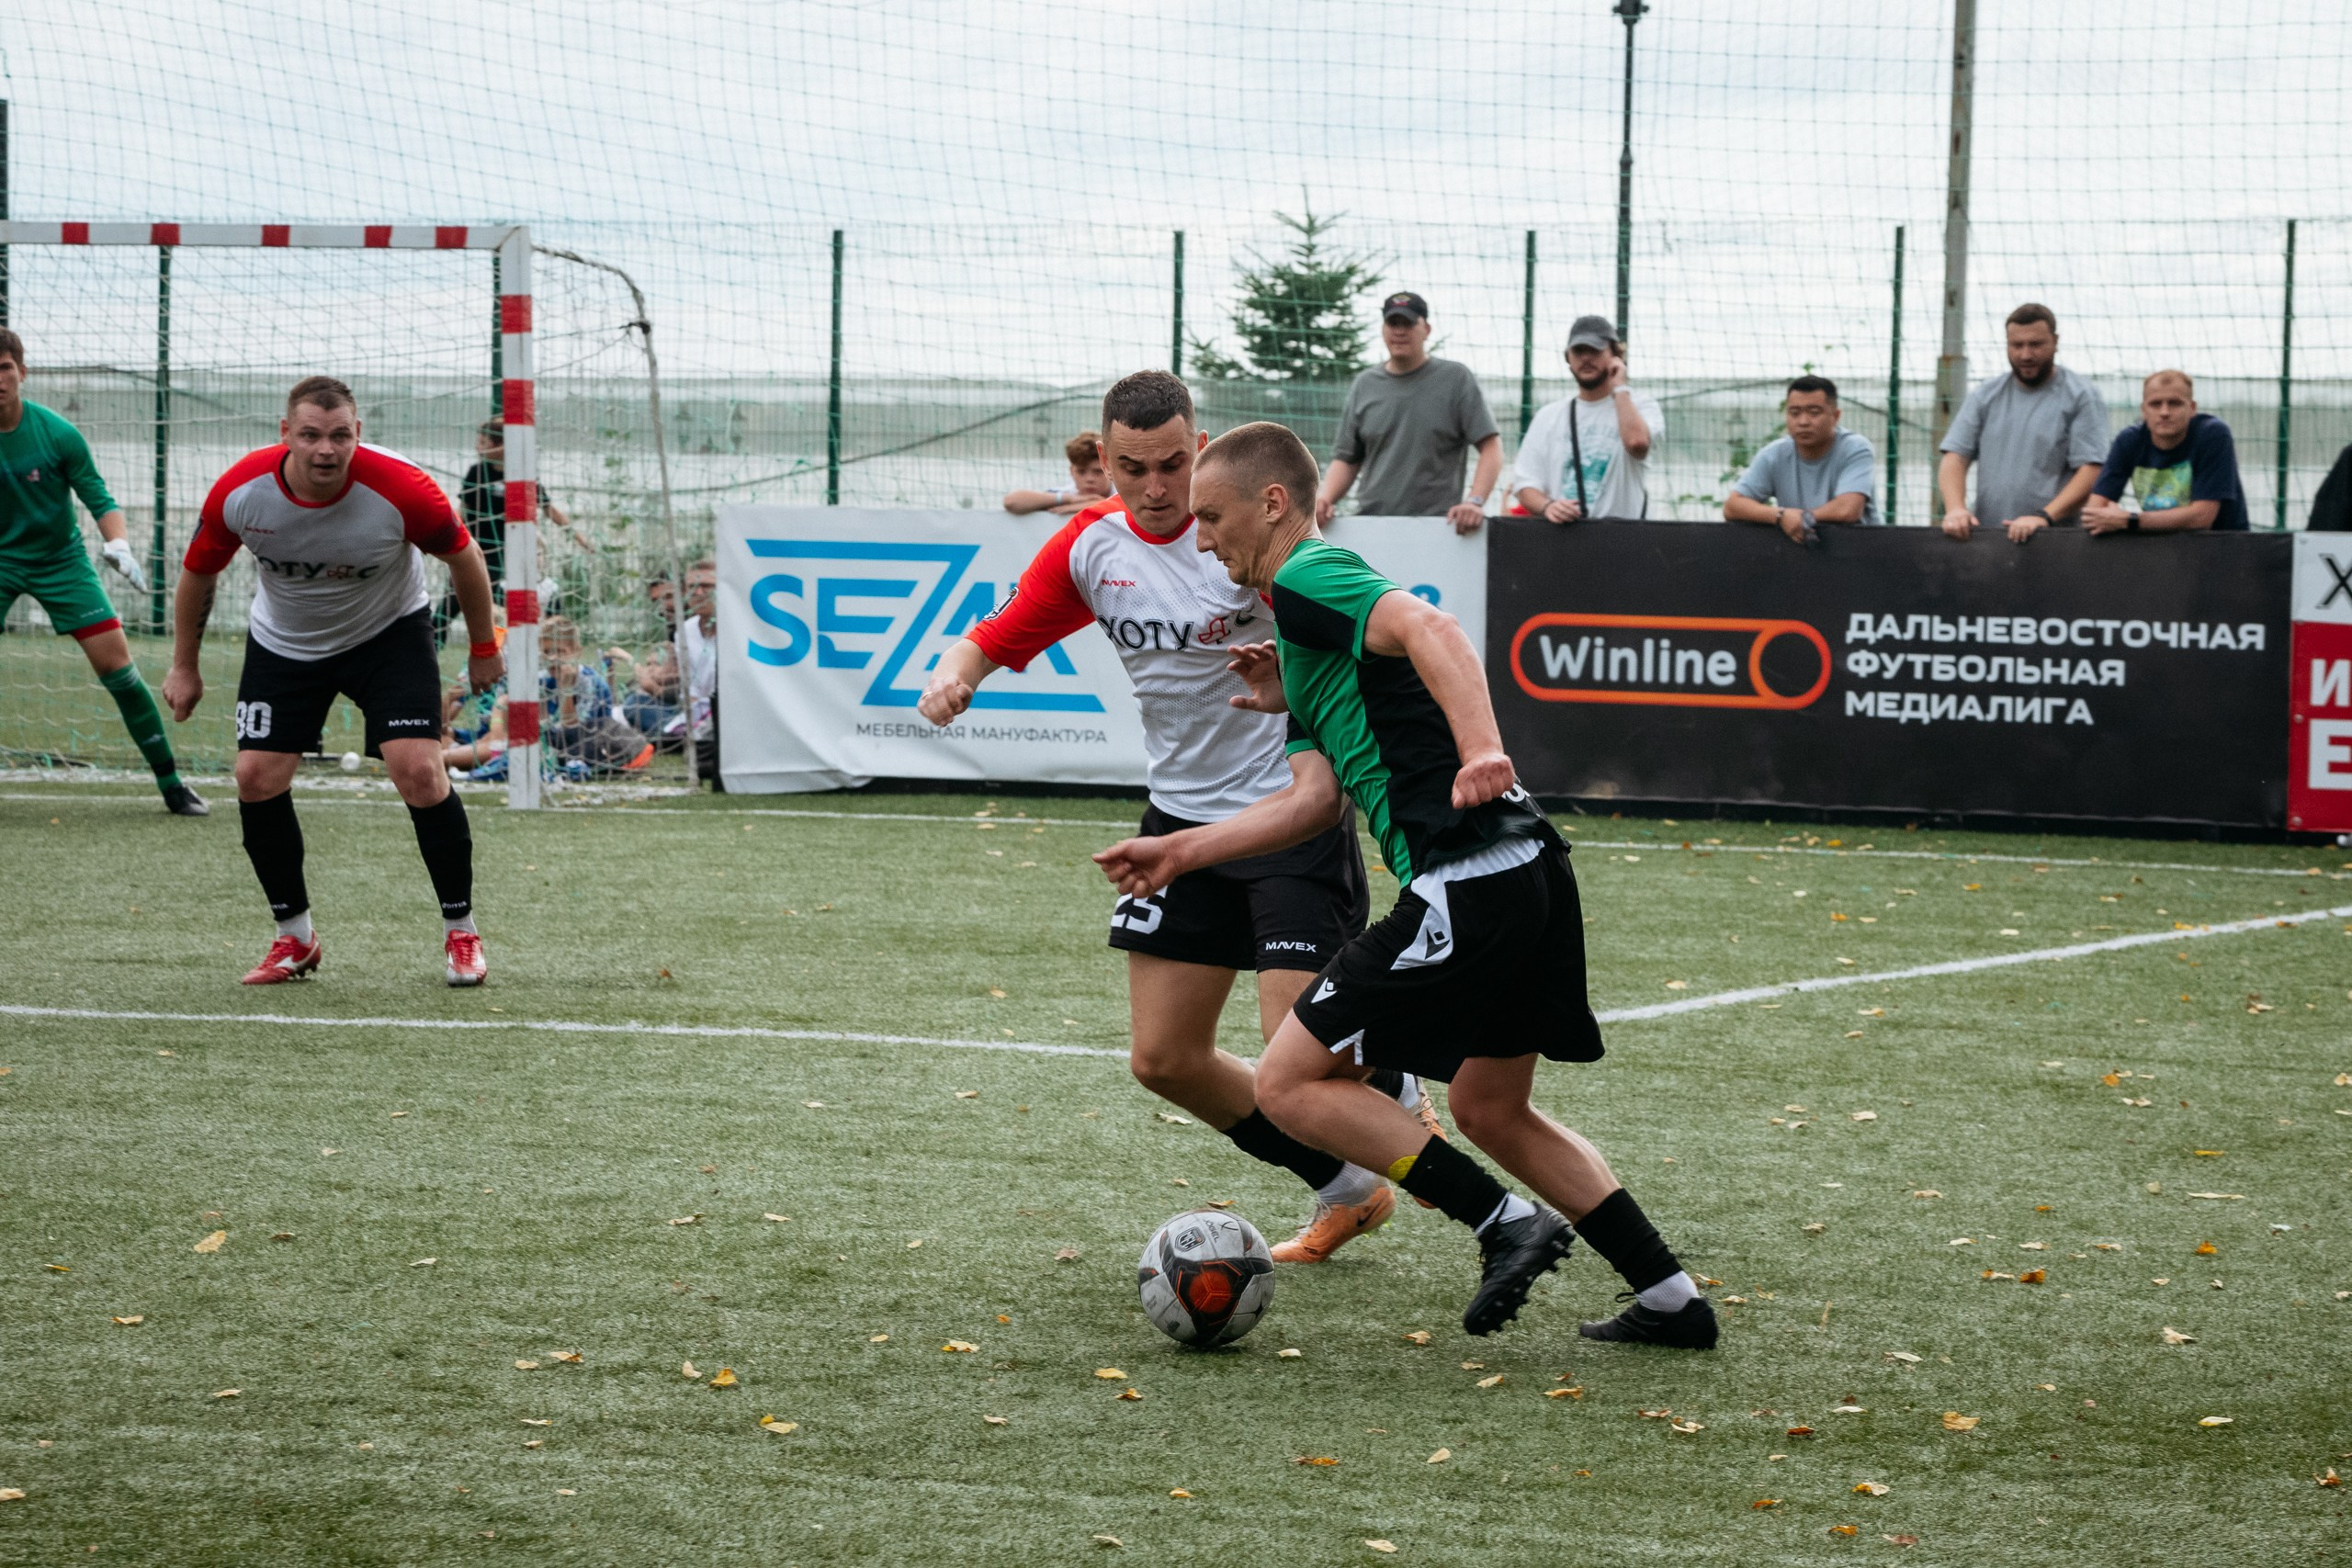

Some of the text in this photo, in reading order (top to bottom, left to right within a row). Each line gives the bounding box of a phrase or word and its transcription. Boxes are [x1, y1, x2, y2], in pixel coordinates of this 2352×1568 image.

[1845, 613, 2266, 650] ДАЛЬНЕВОСТОЧНАЯ
[1539, 635, 1737, 686] Winline
[1846, 649, 2126, 687] ФУТБОЛЬНАЯ
[1845, 691, 2095, 726] МЕДИАЛИГА
[856, 722, 1108, 743] МЕБЕЛЬНАЯ МАНУФАКТУРА
[1266, 942, 1317, 953] MAVEX
